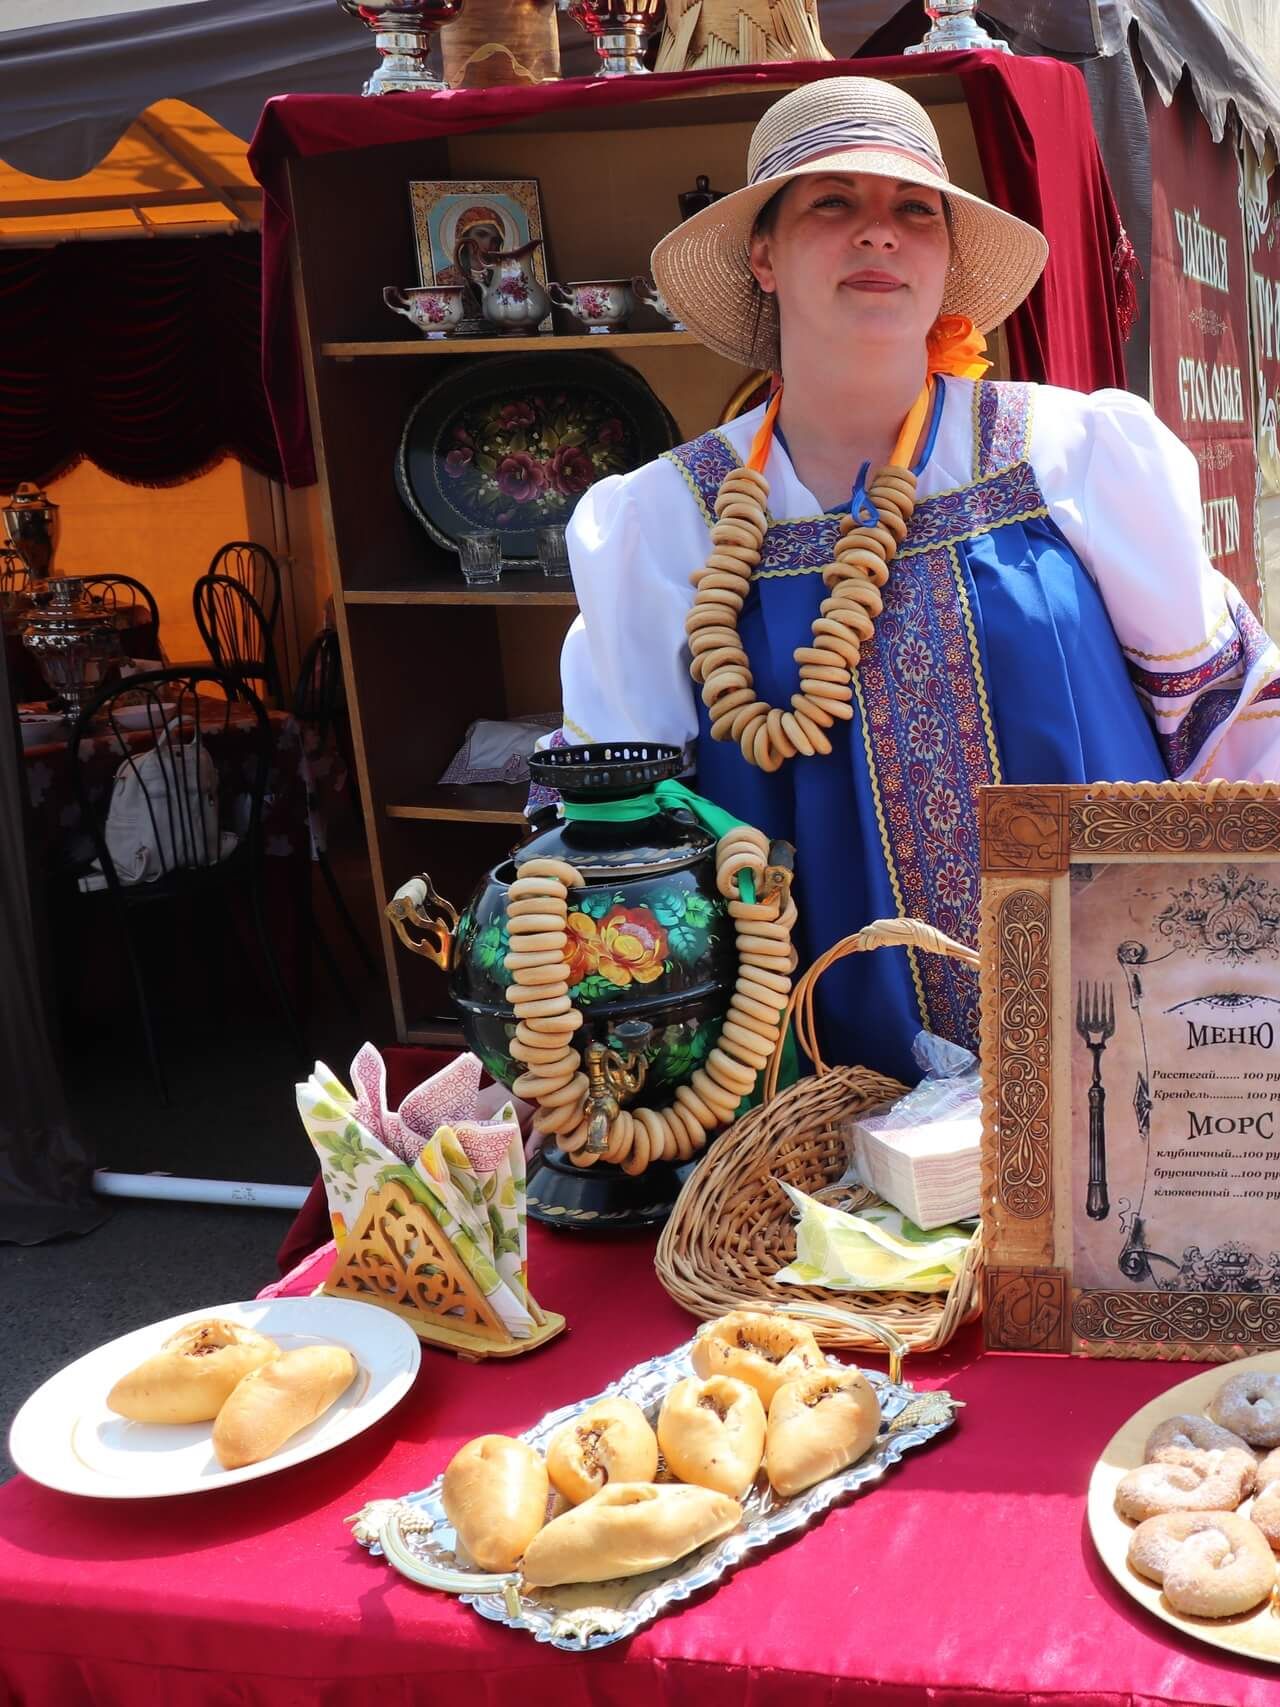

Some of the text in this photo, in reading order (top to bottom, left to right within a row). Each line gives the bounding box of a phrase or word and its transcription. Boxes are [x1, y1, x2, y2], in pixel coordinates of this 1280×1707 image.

[1174, 205, 1229, 295] ЧАЙНАЯ
[1178, 356, 1244, 423] СТОЛОВАЯ
[1187, 1020, 1274, 1050] МЕНЮ
[1243, 1072, 1263, 1080] 100
[1247, 1091, 1268, 1100] 100
[1187, 1110, 1274, 1140] МОРС
[1153, 1168, 1228, 1179] брусничный
[1153, 1187, 1230, 1198] клюквенный
